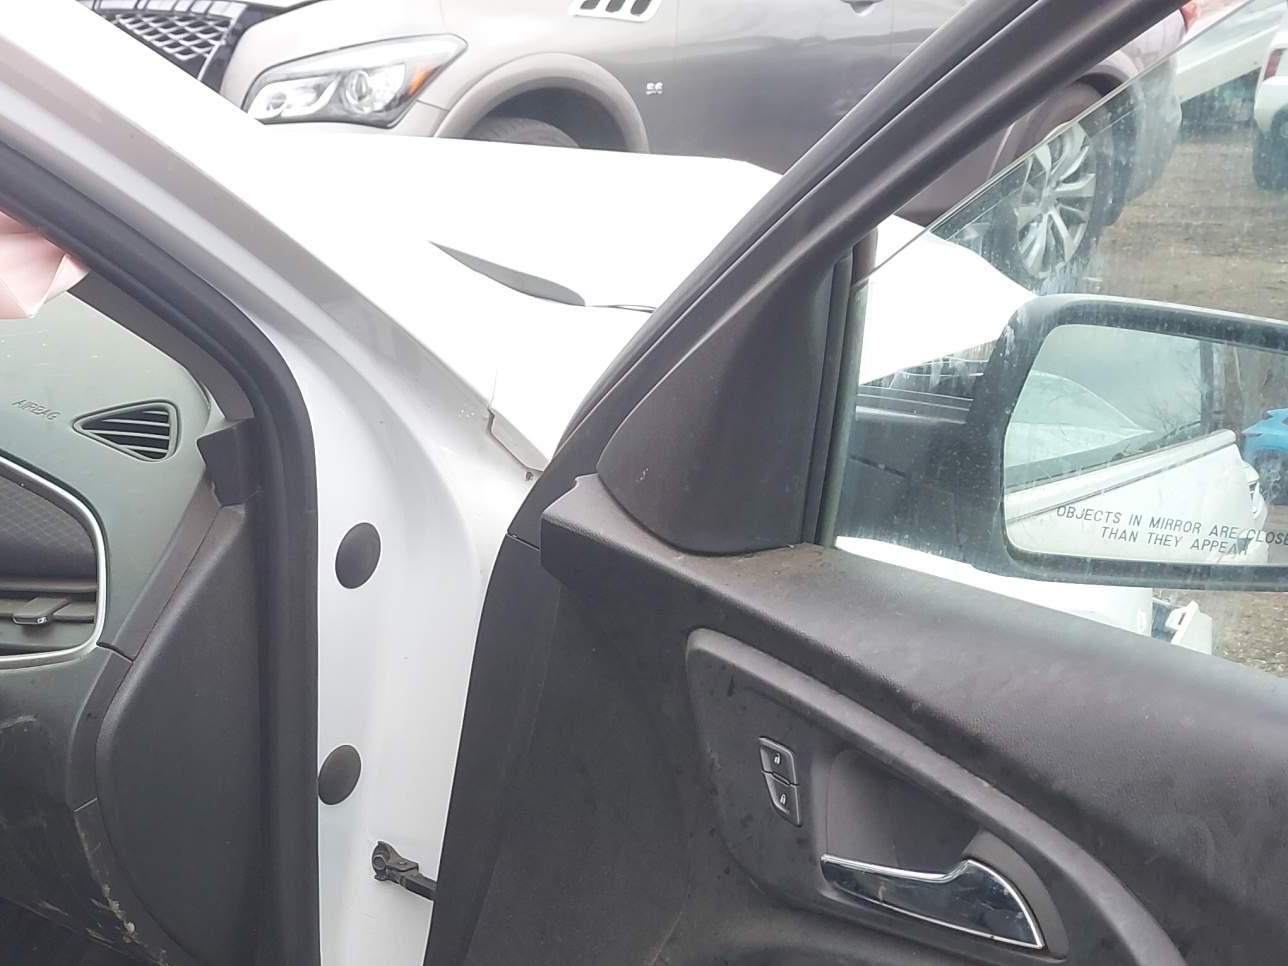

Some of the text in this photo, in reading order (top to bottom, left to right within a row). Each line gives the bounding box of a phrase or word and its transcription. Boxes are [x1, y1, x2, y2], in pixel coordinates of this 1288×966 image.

[12, 399, 63, 421] AIRBAG
[1056, 505, 1122, 525] OBJECTS
[1128, 514, 1143, 527] IN
[1149, 516, 1202, 534] MIRROR
[1210, 524, 1238, 540] ARE
[1101, 526, 1139, 543] THAN
[1147, 531, 1184, 548] THEY
